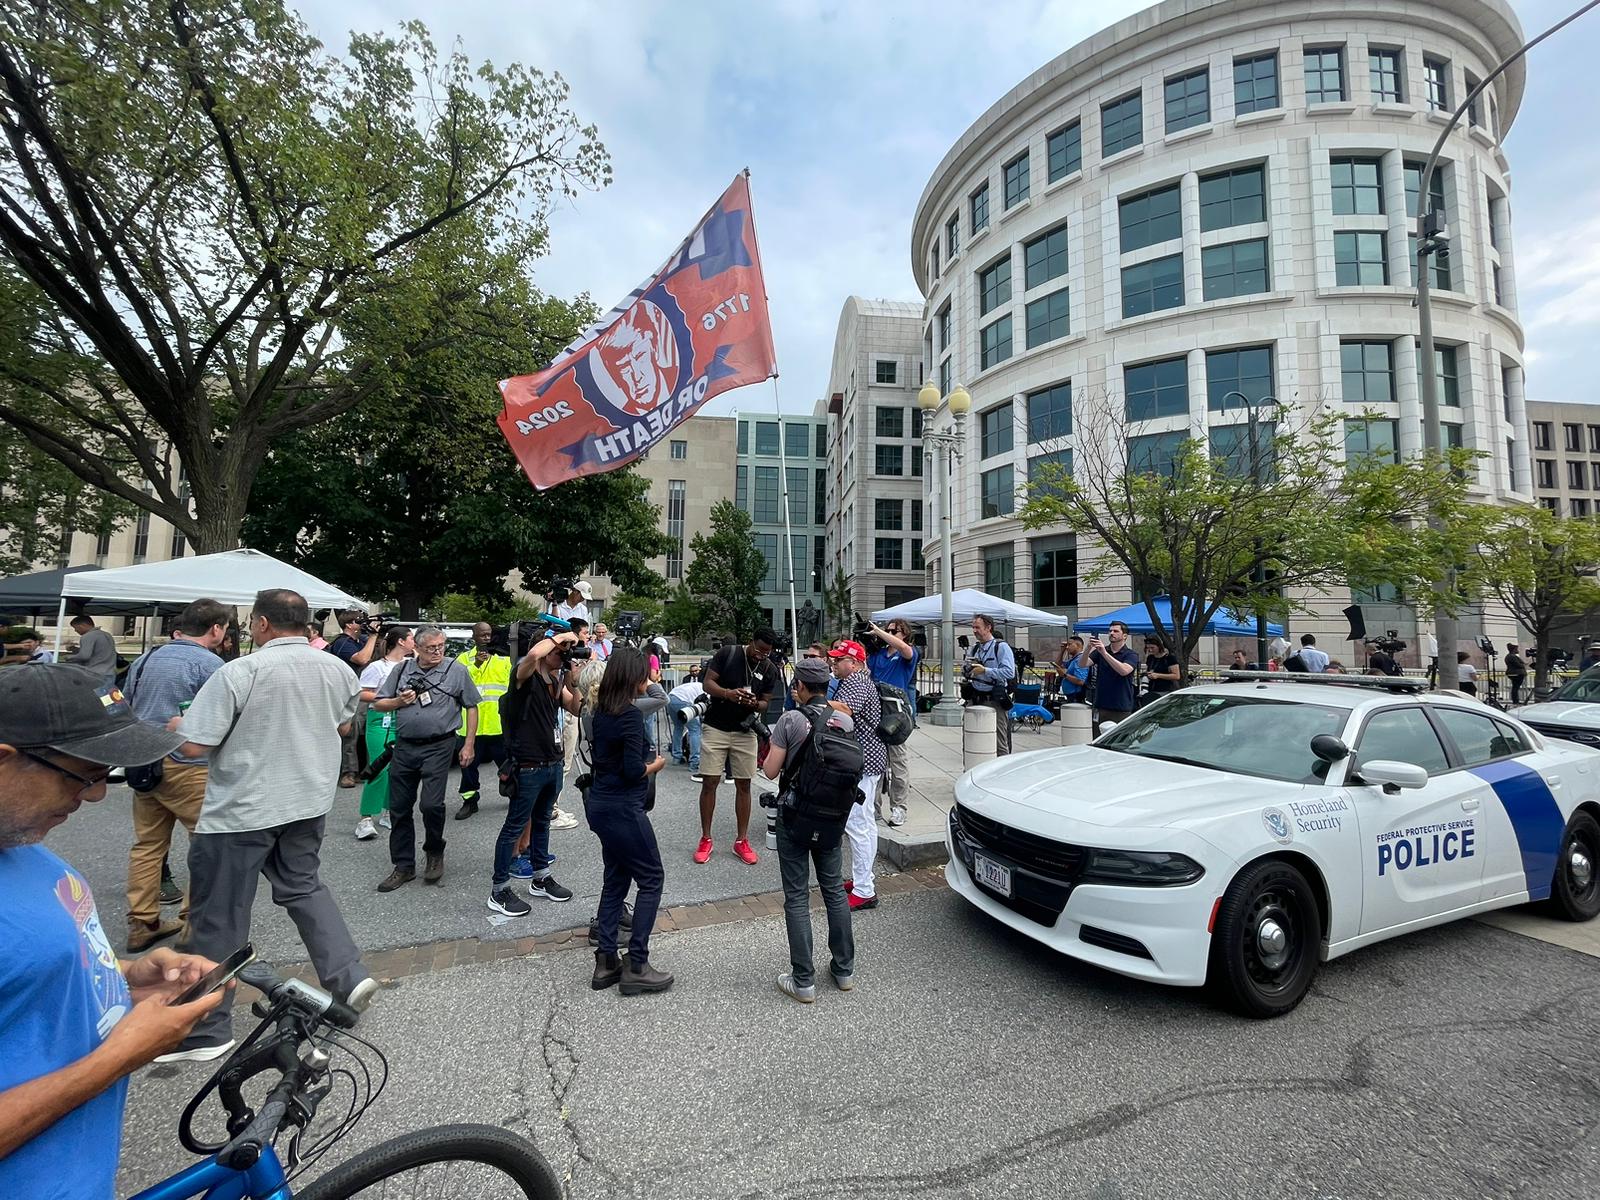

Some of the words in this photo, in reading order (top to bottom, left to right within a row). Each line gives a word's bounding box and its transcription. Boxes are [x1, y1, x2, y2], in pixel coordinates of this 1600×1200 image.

[1288, 796, 1348, 816] Homeland
[1296, 815, 1341, 833] Security
[1376, 829, 1404, 843] FEDERAL
[1405, 823, 1447, 837] PROTECTIVE
[1447, 819, 1475, 831] SERVICE
[1377, 829, 1475, 877] POLICE
